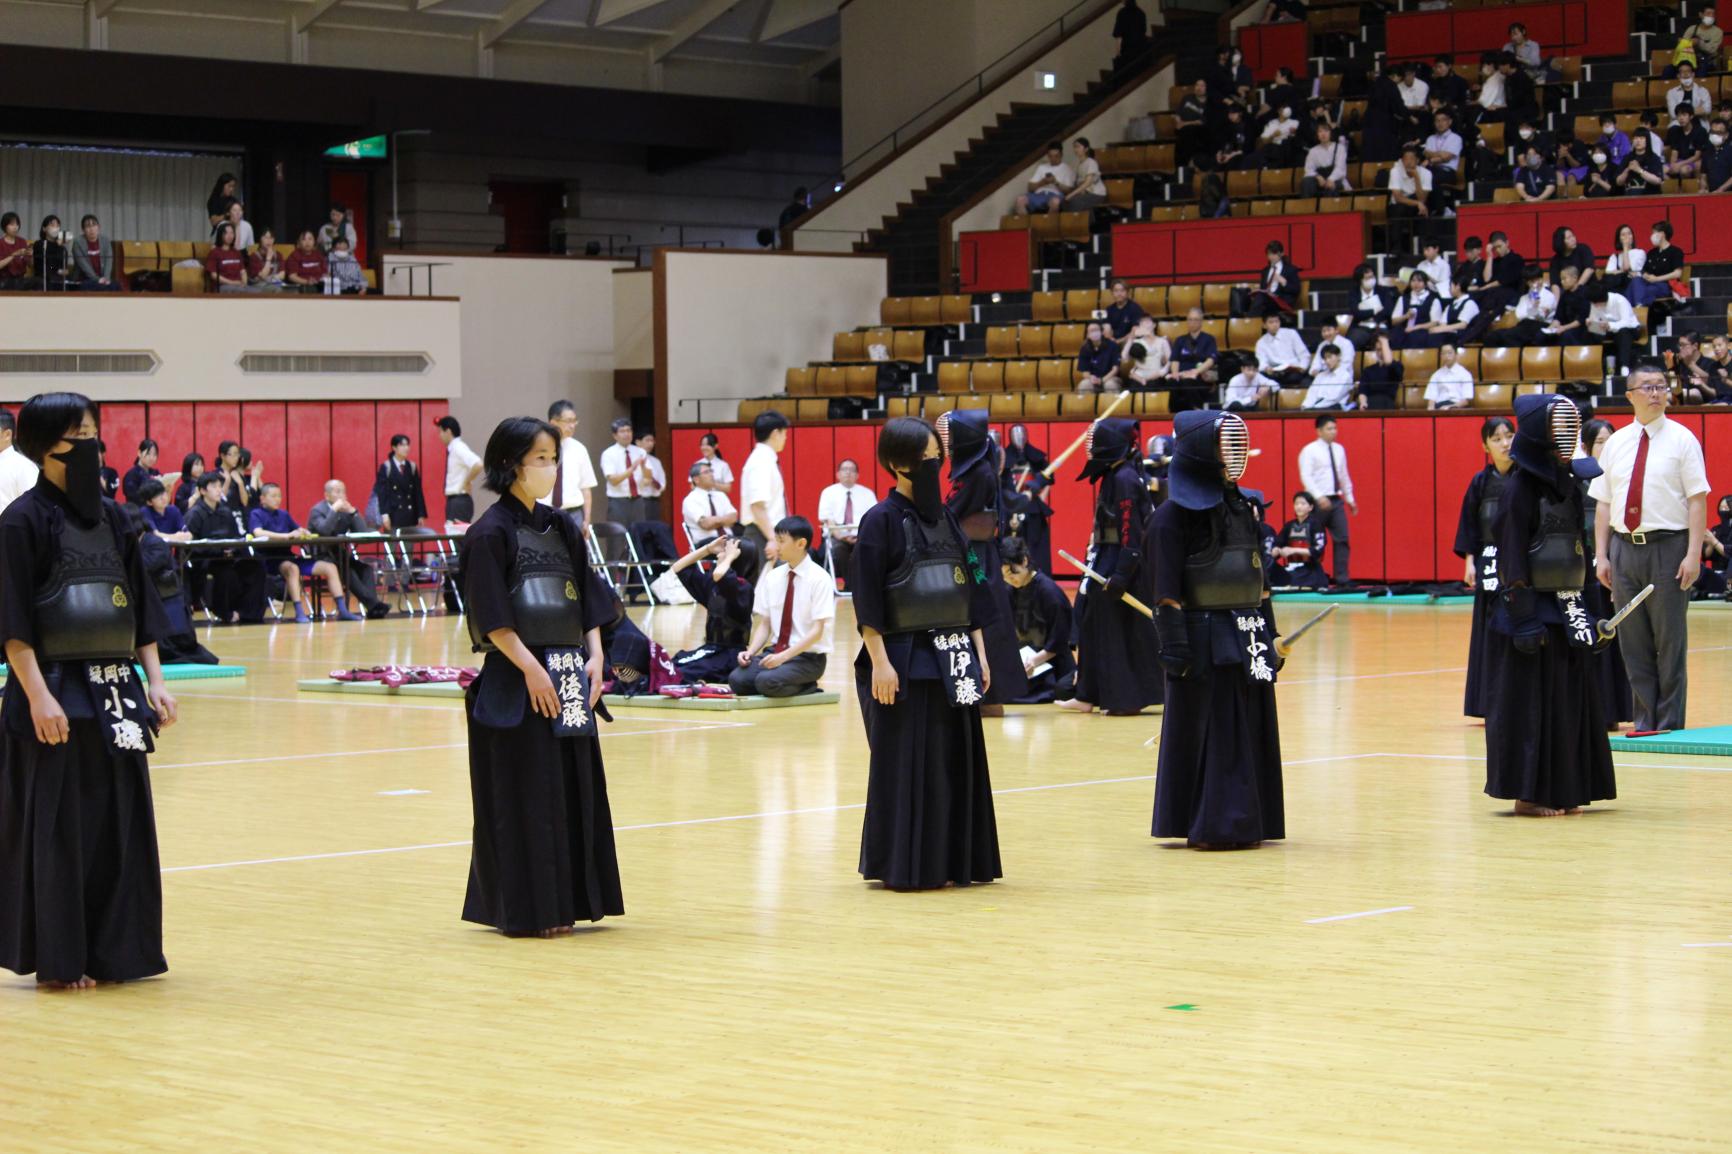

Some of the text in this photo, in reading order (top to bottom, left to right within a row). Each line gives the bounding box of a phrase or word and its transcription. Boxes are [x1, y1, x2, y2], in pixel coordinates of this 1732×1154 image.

[1565, 601, 1593, 646] 長谷川
[559, 673, 589, 727] 後藤
